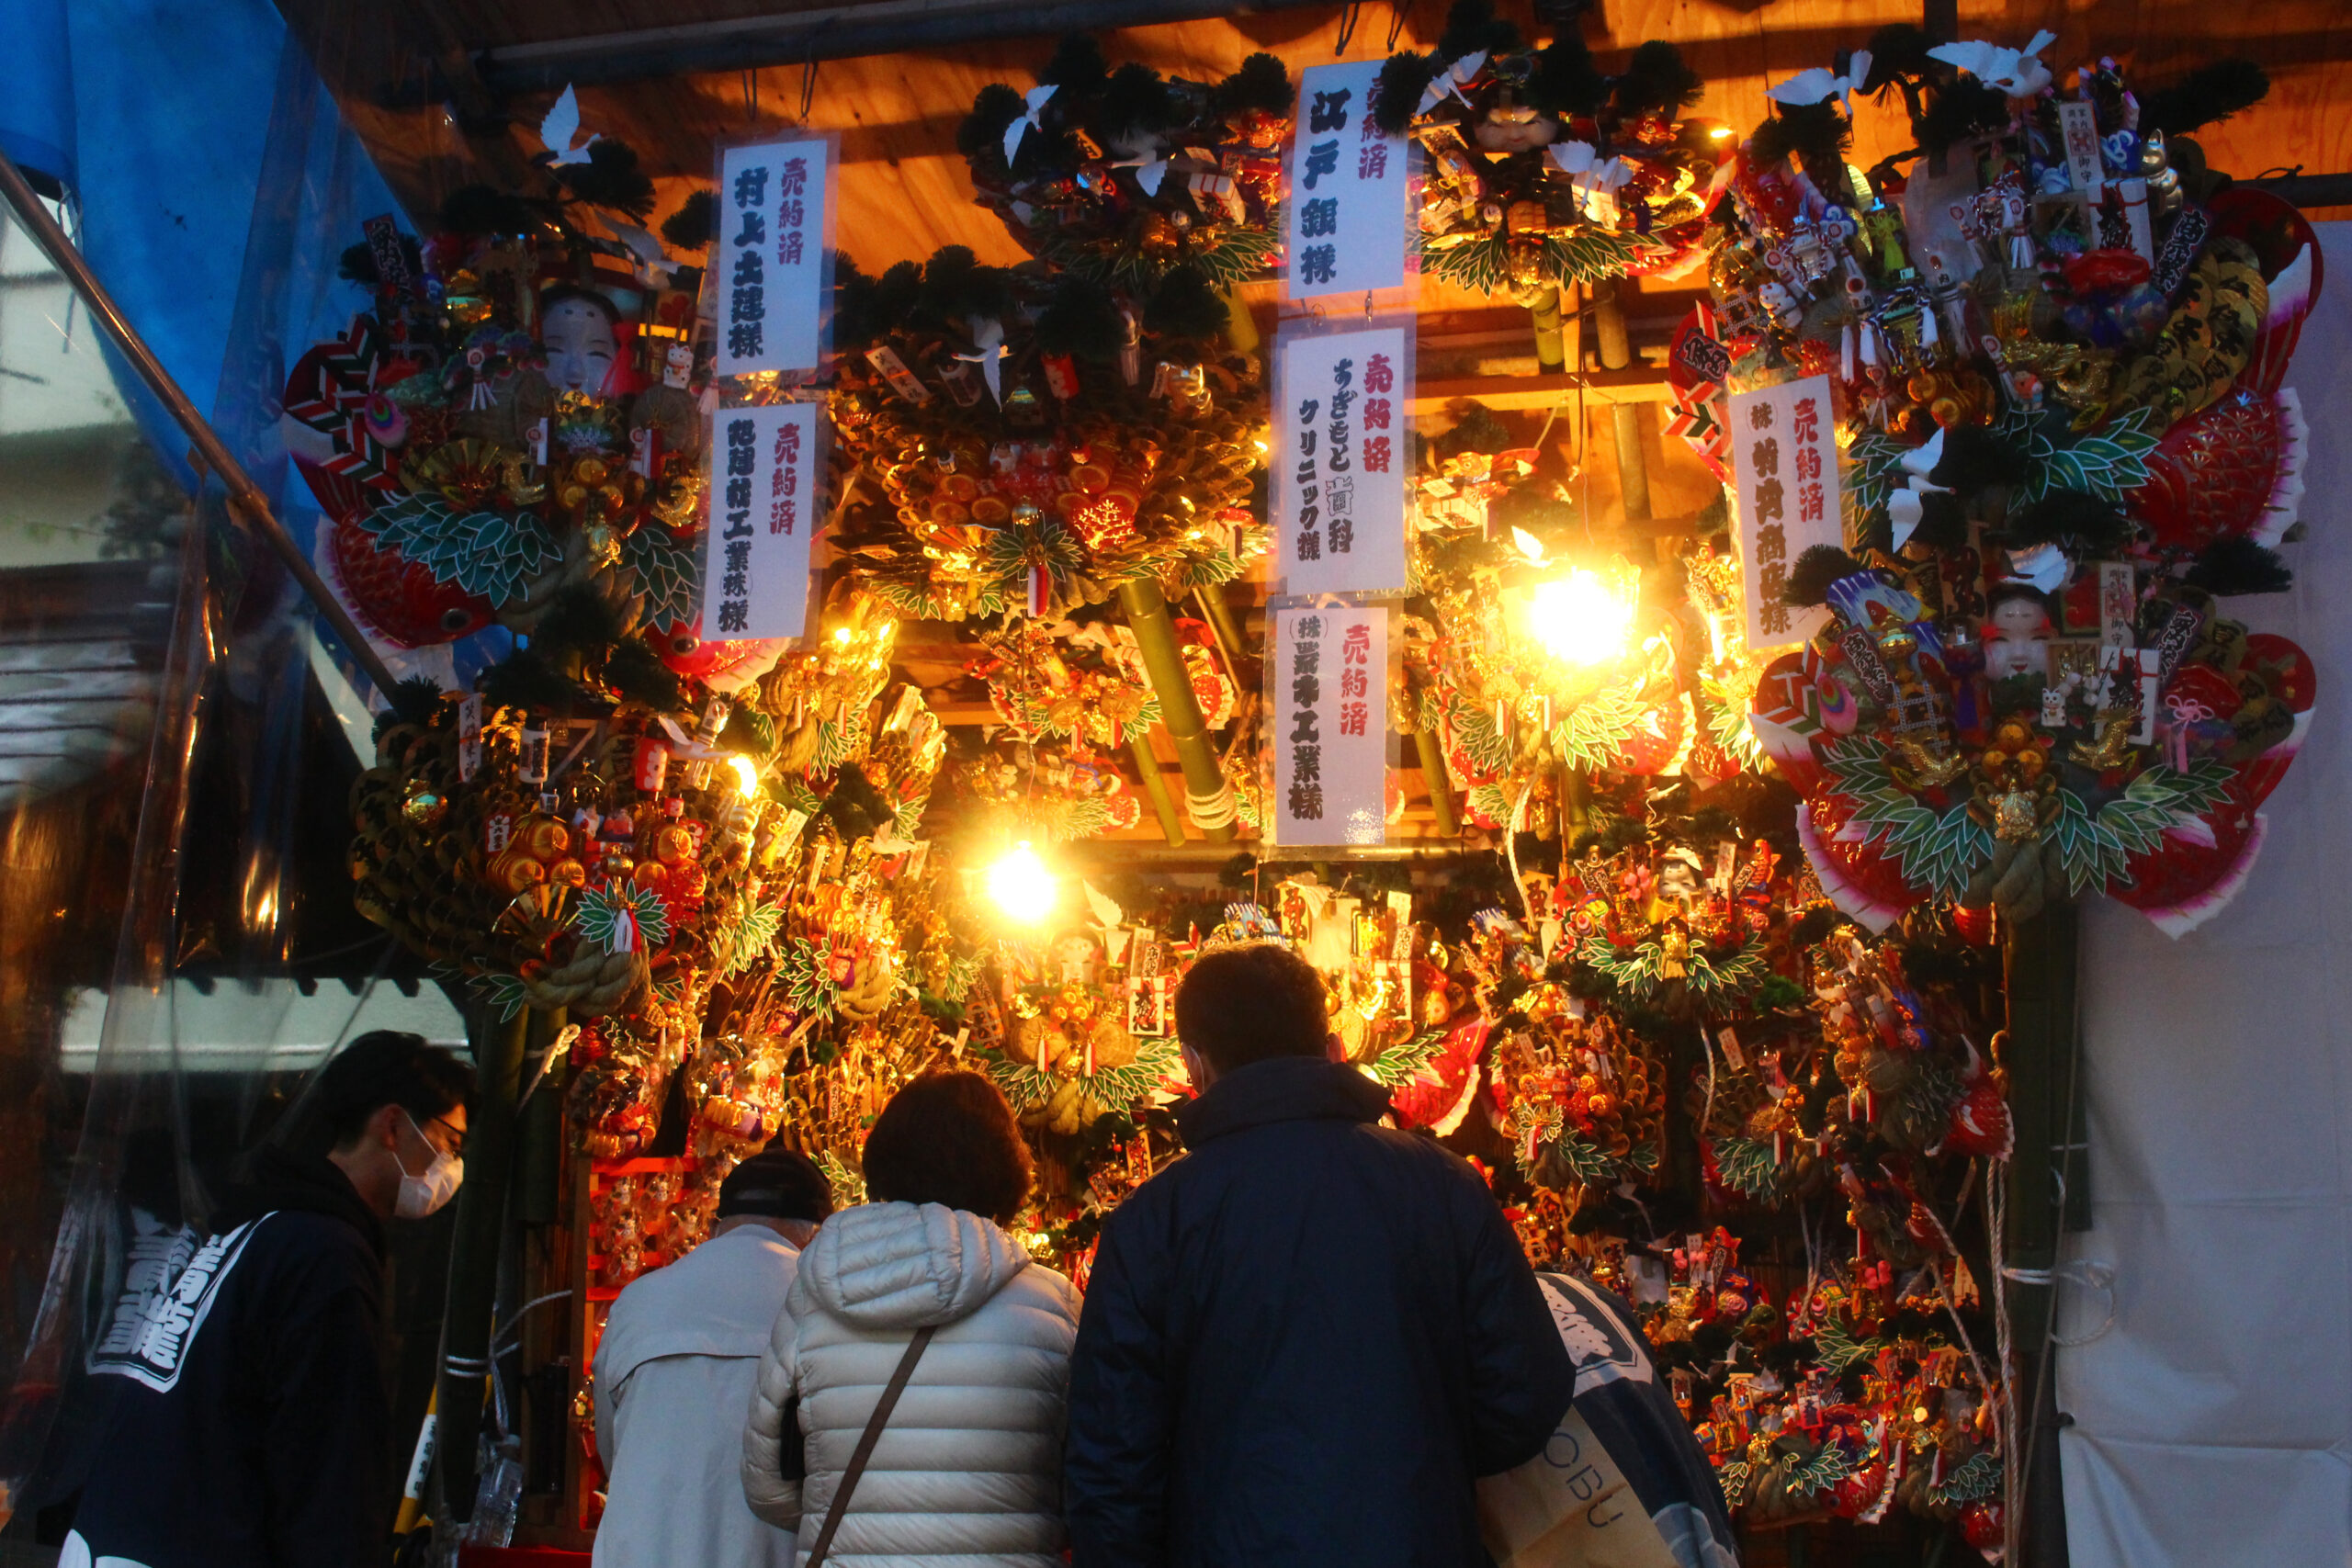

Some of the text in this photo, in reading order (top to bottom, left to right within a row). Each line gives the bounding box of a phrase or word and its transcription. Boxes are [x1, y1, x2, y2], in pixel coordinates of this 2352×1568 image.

[728, 166, 769, 359] 村上土建様
[777, 157, 808, 265] 売約済
[1363, 353, 1394, 473] 売約済
[1793, 397, 1825, 523] 売約済
[770, 422, 801, 536] 売約済
[1296, 398, 1321, 561] クリニック様
[1340, 624, 1371, 737] 売約済
